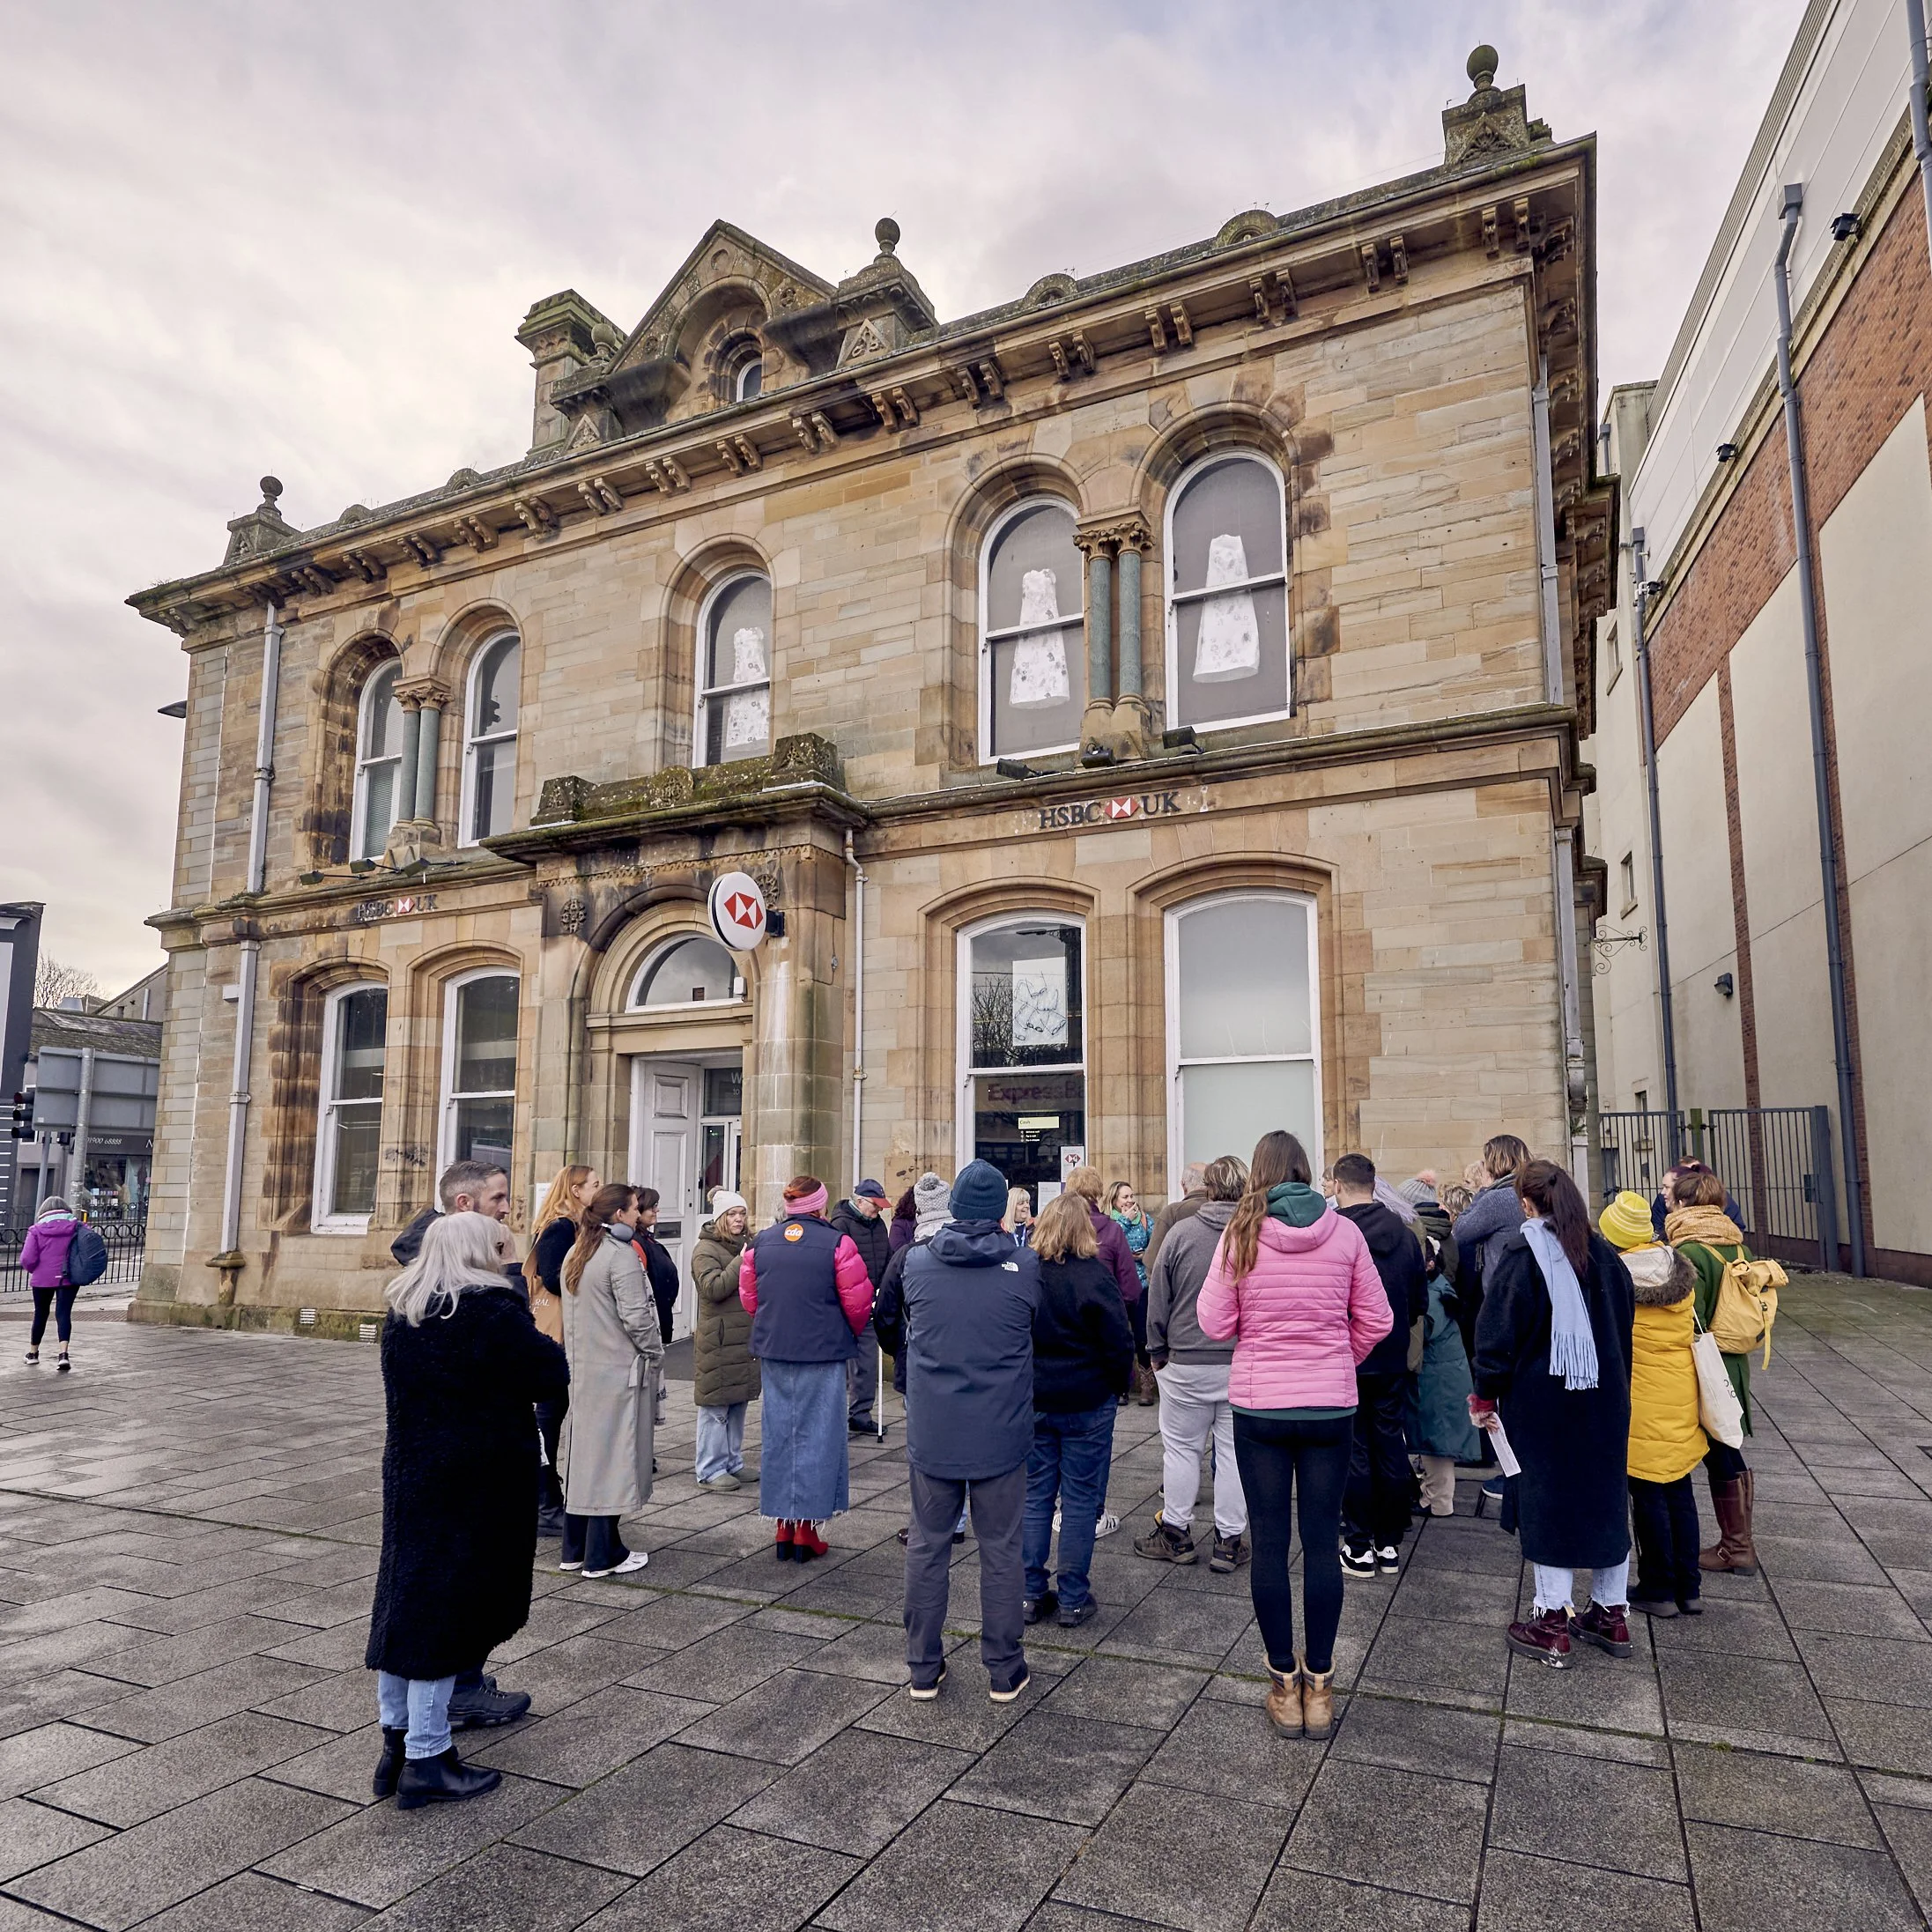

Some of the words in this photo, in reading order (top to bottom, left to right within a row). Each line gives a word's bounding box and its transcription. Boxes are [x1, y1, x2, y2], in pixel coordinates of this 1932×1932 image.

[1039, 801, 1101, 829] HSBC
[1141, 791, 1181, 816] UK
[357, 899, 395, 917] HSBC
